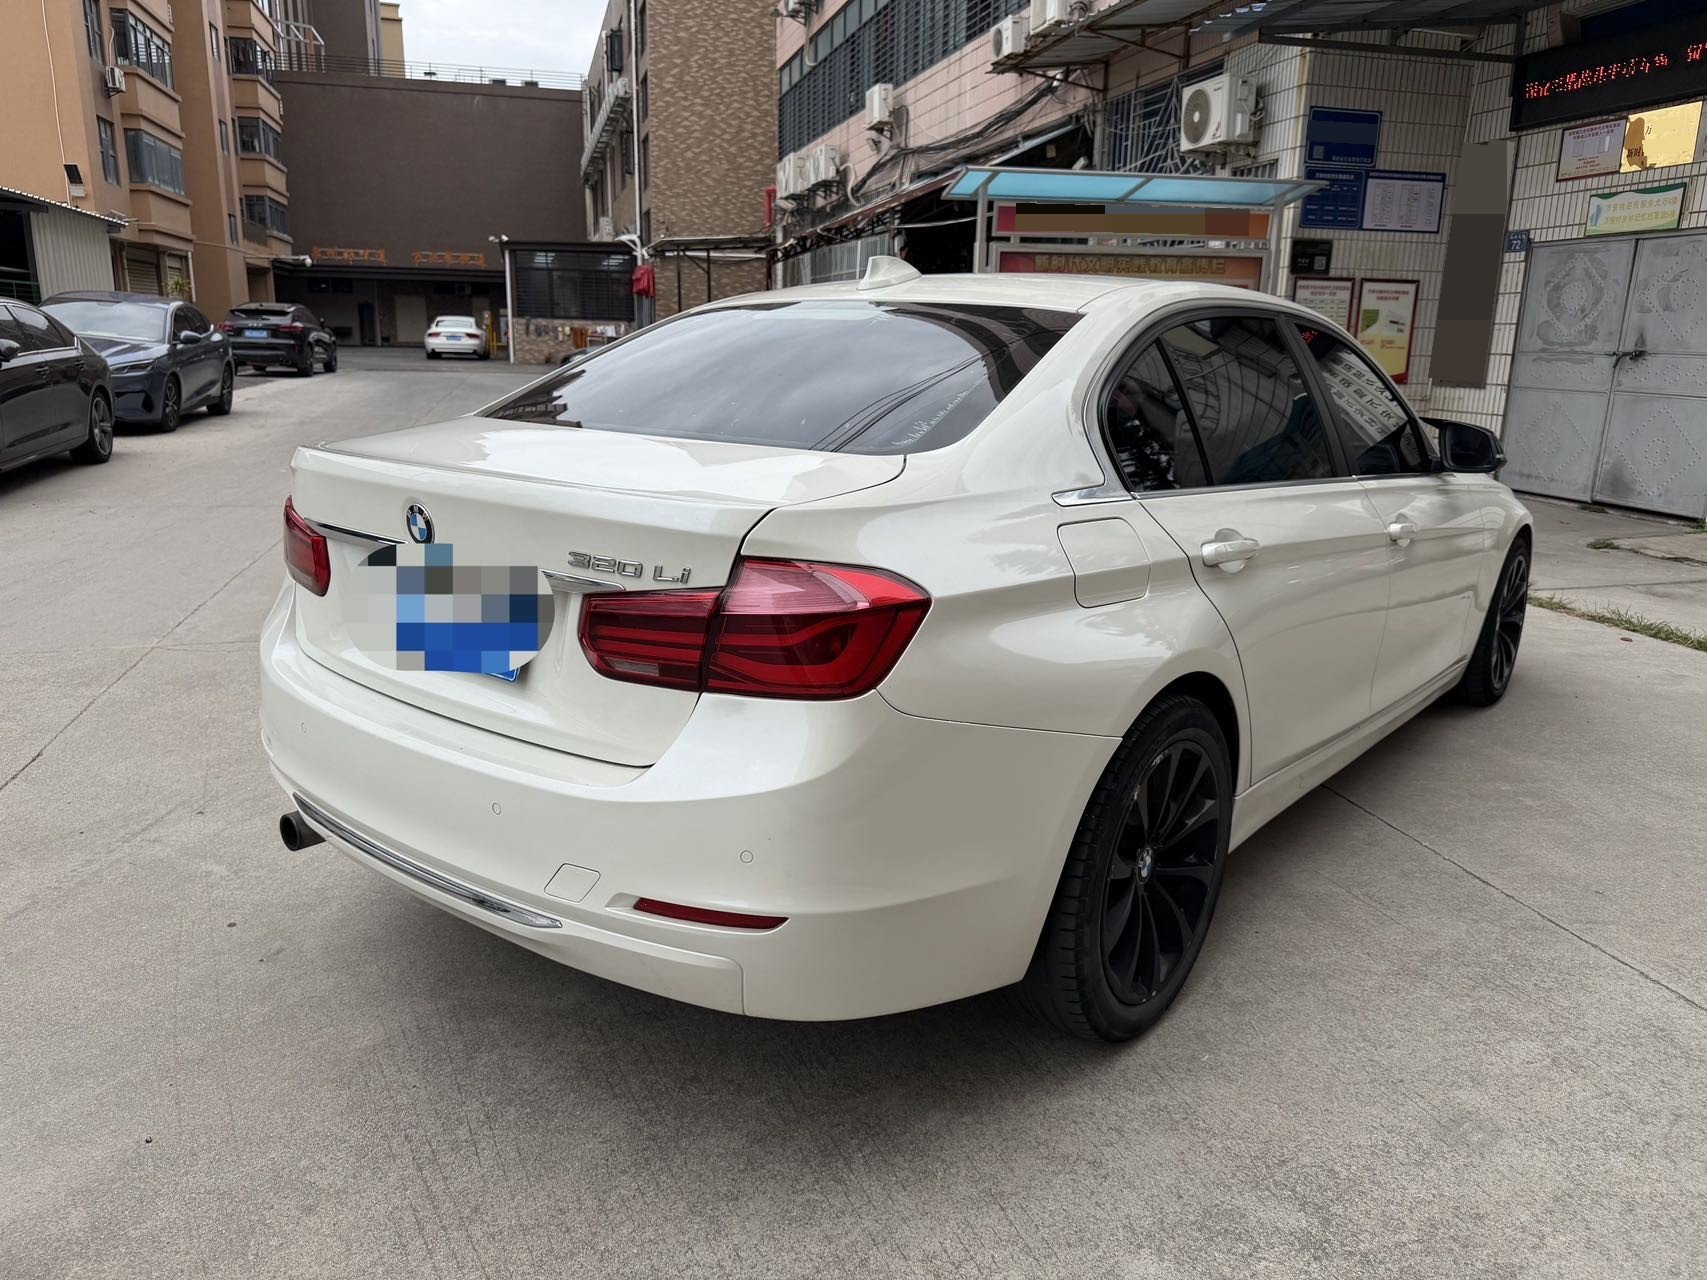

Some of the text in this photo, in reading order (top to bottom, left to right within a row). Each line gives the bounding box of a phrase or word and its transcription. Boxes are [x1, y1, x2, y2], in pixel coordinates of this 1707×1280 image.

[1511, 240, 1521, 250] 72
[567, 551, 691, 584] 320 Li
